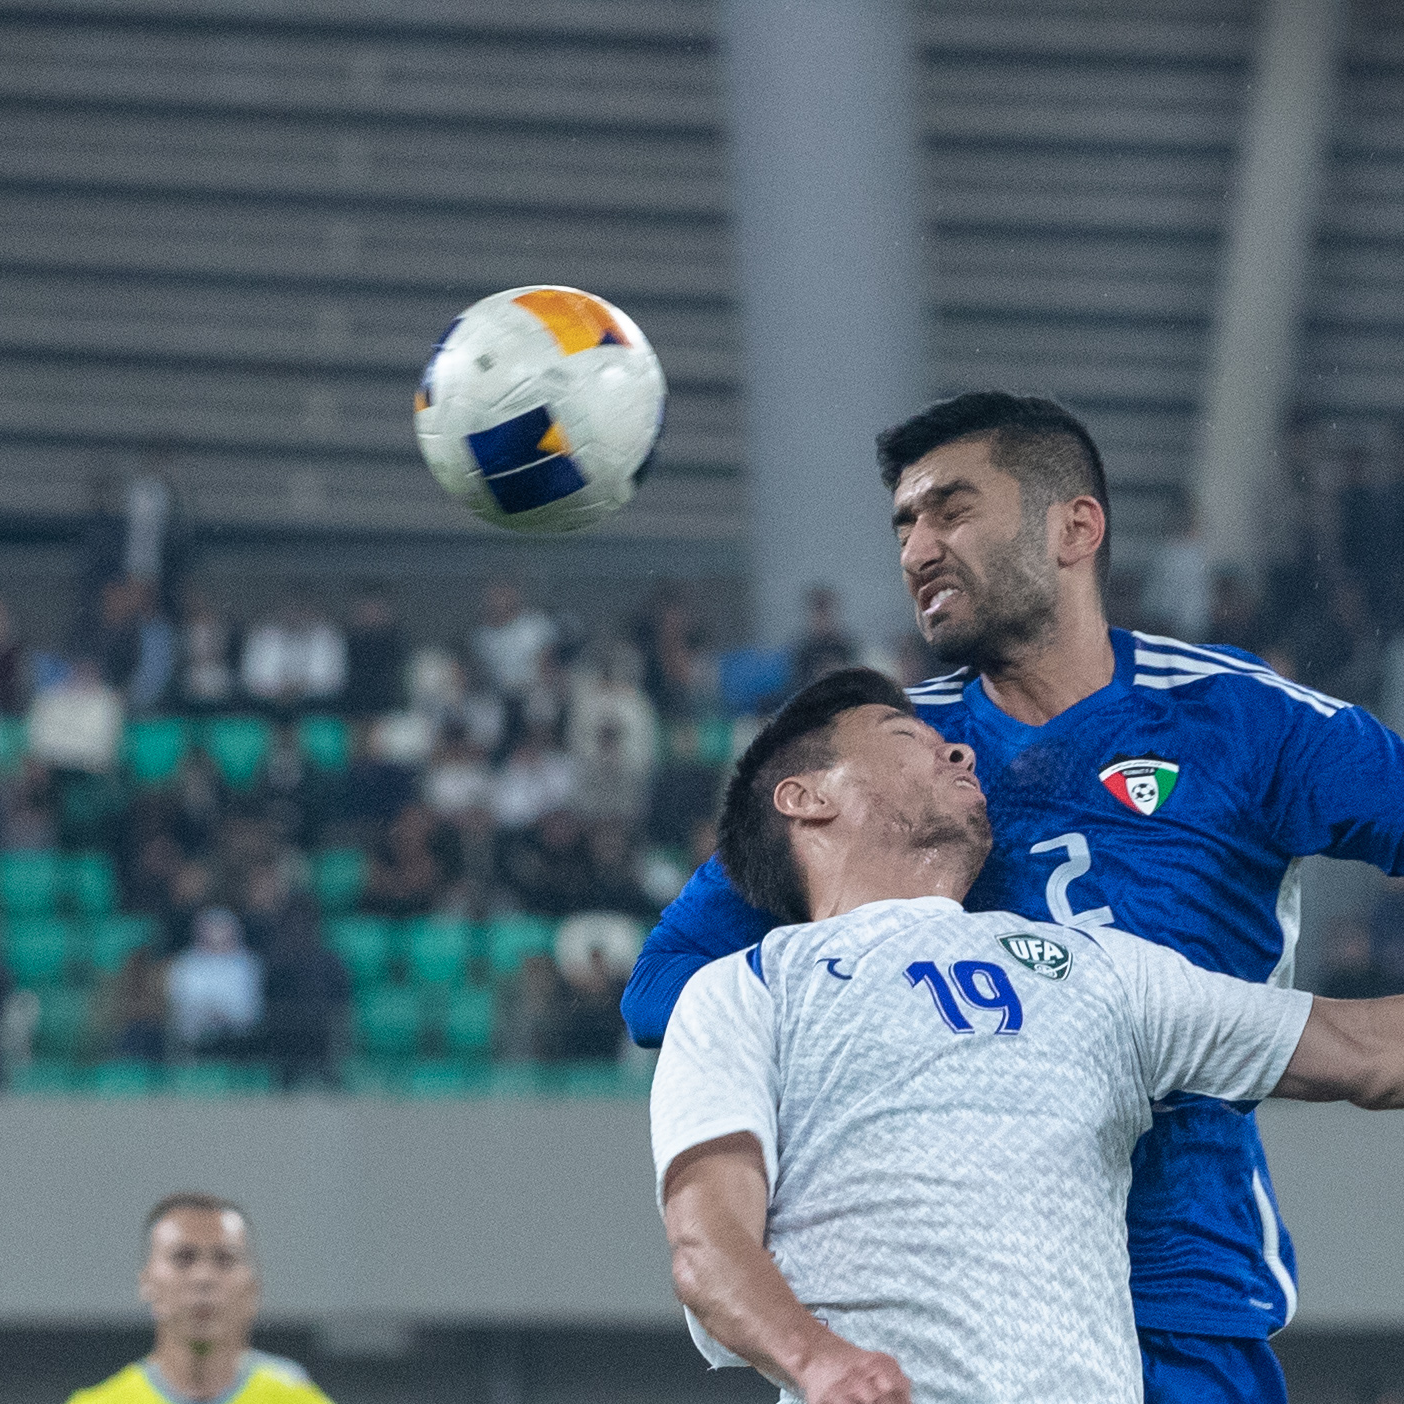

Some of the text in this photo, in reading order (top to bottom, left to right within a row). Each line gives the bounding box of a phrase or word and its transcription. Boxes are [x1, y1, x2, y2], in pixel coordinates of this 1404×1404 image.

[1028, 832, 1115, 928] 2
[1008, 938, 1065, 961] UFA
[902, 960, 1024, 1036] 19
